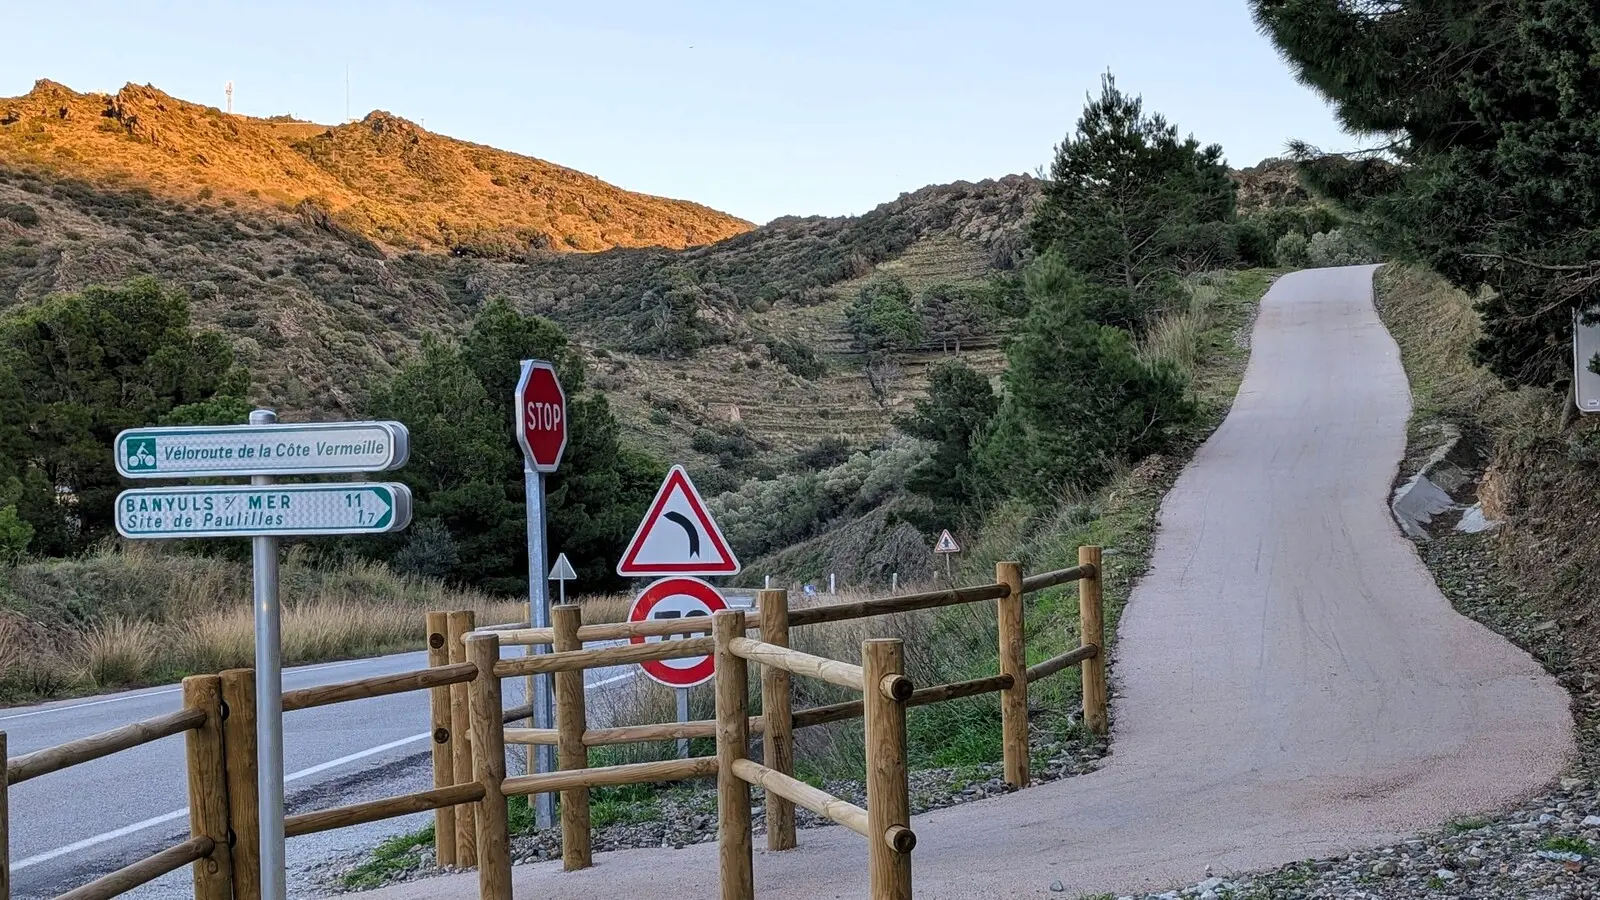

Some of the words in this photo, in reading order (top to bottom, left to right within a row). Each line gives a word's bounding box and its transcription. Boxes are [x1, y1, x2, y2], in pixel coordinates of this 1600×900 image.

[527, 401, 561, 431] STOP
[164, 445, 233, 461] Véloroute
[237, 445, 255, 458] de
[259, 444, 271, 457] la
[276, 441, 310, 457] Côte
[315, 439, 384, 456] Vermeille
[126, 497, 214, 513] BANYULS
[249, 495, 291, 509] MER
[345, 493, 362, 507] 11
[127, 514, 163, 528] Site
[173, 514, 193, 527] de
[203, 512, 284, 527] Paulilles
